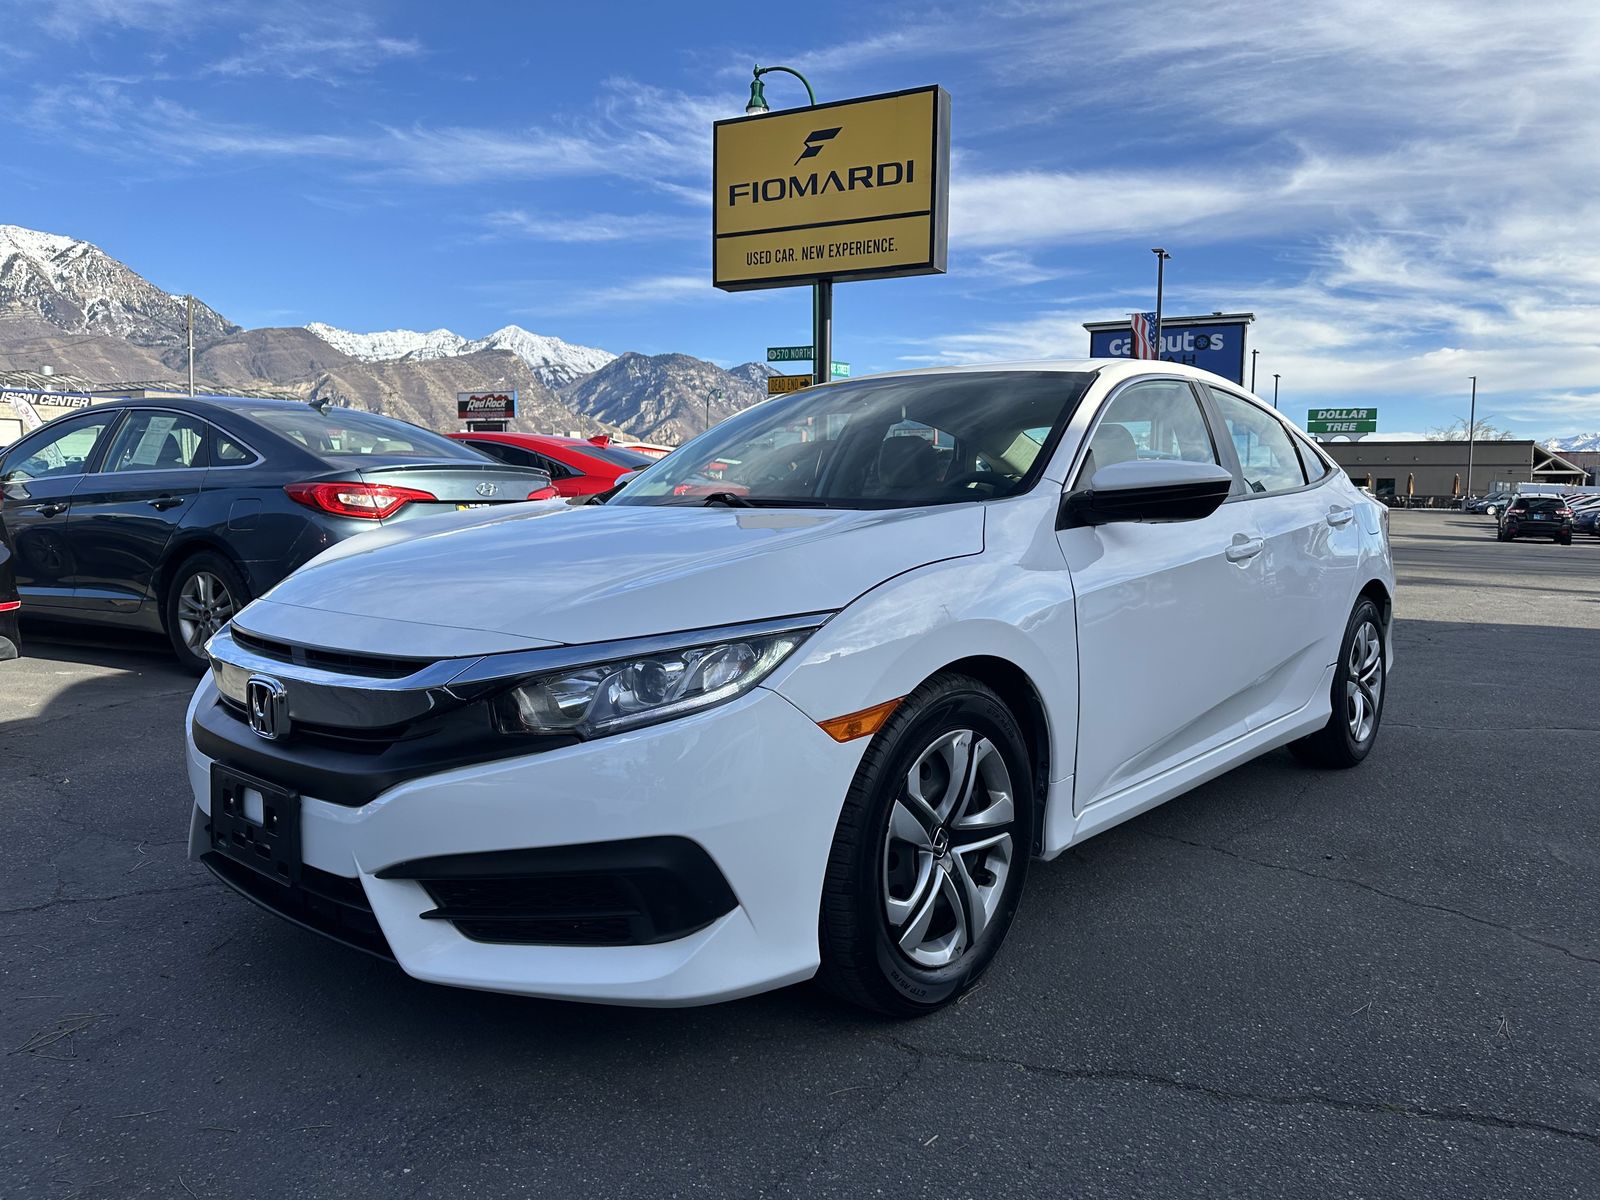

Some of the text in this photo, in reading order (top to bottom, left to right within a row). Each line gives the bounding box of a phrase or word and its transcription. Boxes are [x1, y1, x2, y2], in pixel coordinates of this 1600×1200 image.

[729, 159, 914, 207] FIOMARDI
[746, 237, 899, 266] USED CAR. NEW EXPERIENCE.
[776, 348, 811, 360] 570 NORTH
[770, 378, 799, 392] DEAD END
[40, 394, 90, 408] CENTER
[466, 398, 486, 411] Red
[485, 397, 507, 408] Rock
[1317, 409, 1368, 419] DOLLAR
[1326, 422, 1358, 432] TREE
